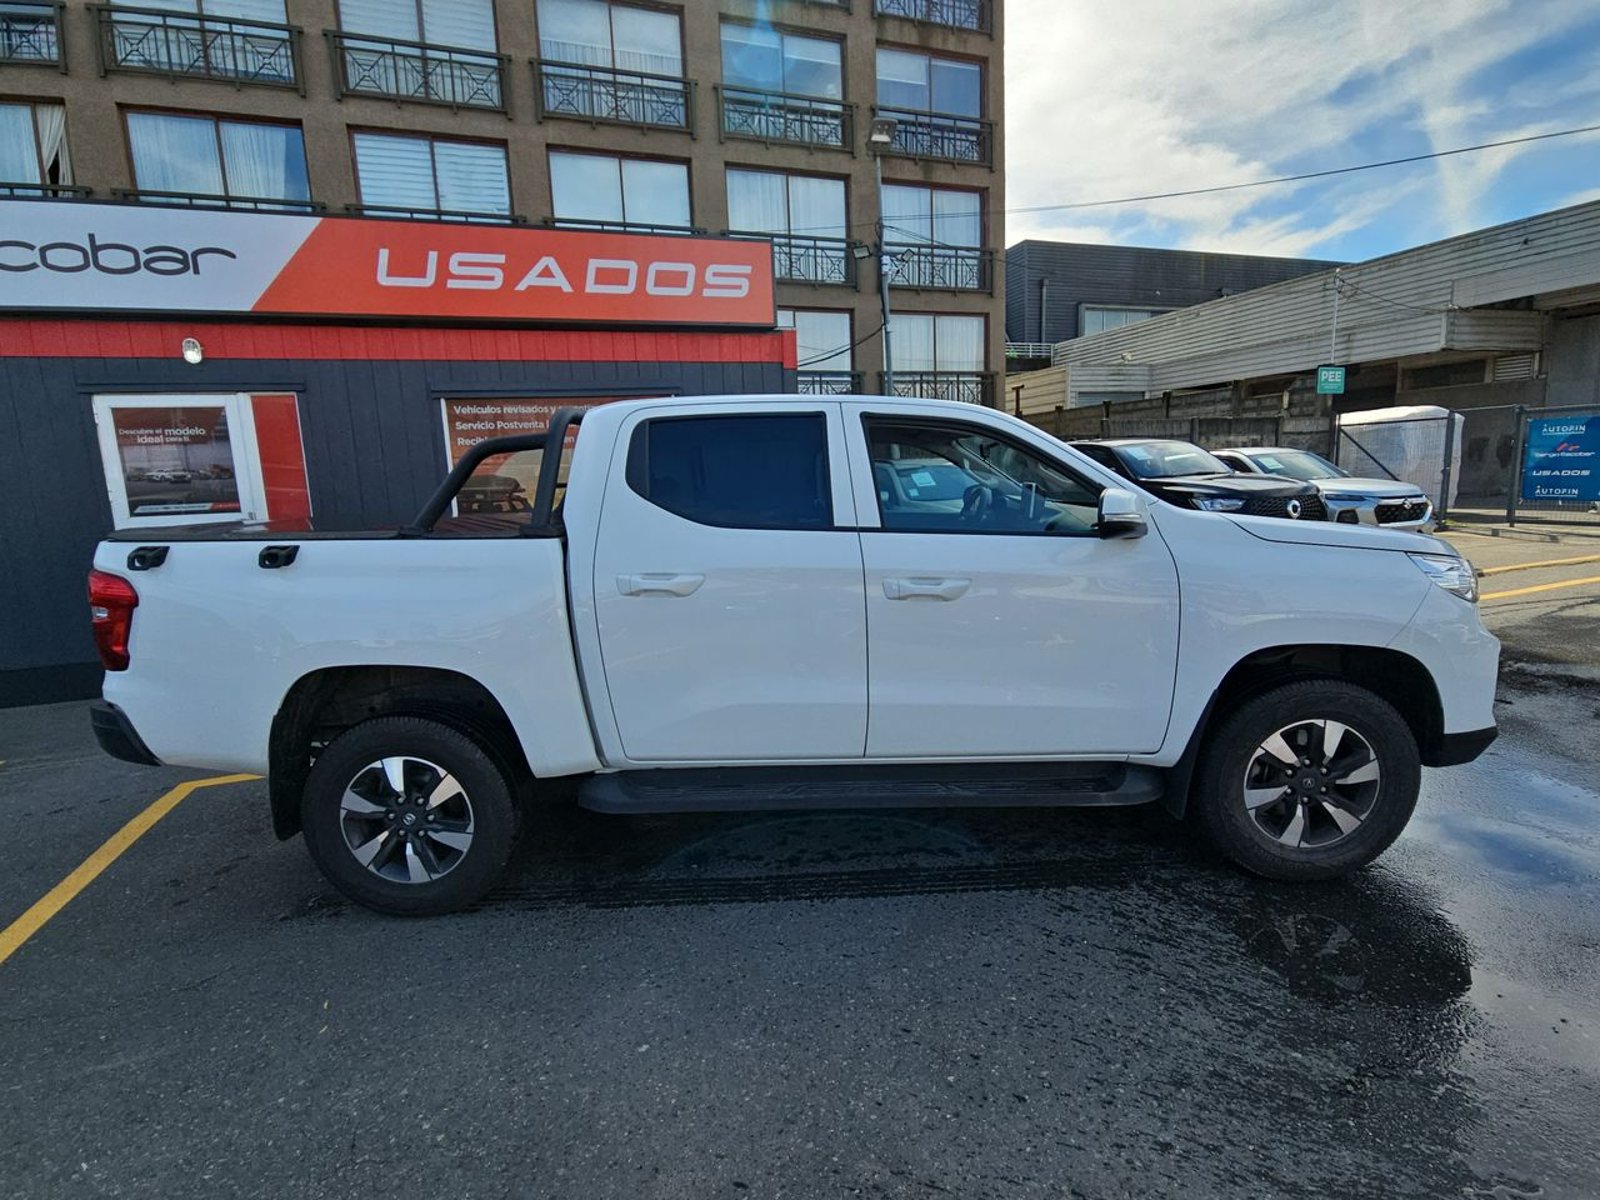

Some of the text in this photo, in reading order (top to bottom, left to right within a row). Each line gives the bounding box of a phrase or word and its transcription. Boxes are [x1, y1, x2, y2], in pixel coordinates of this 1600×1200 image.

[0, 233, 753, 297] cobar USADOS
[1321, 371, 1342, 382] PEE
[503, 404, 549, 413] revisados
[550, 405, 556, 414] y
[455, 421, 495, 430] Servicio
[496, 419, 545, 429] Postventa
[164, 426, 206, 435] modelo
[137, 435, 164, 444] ideal
